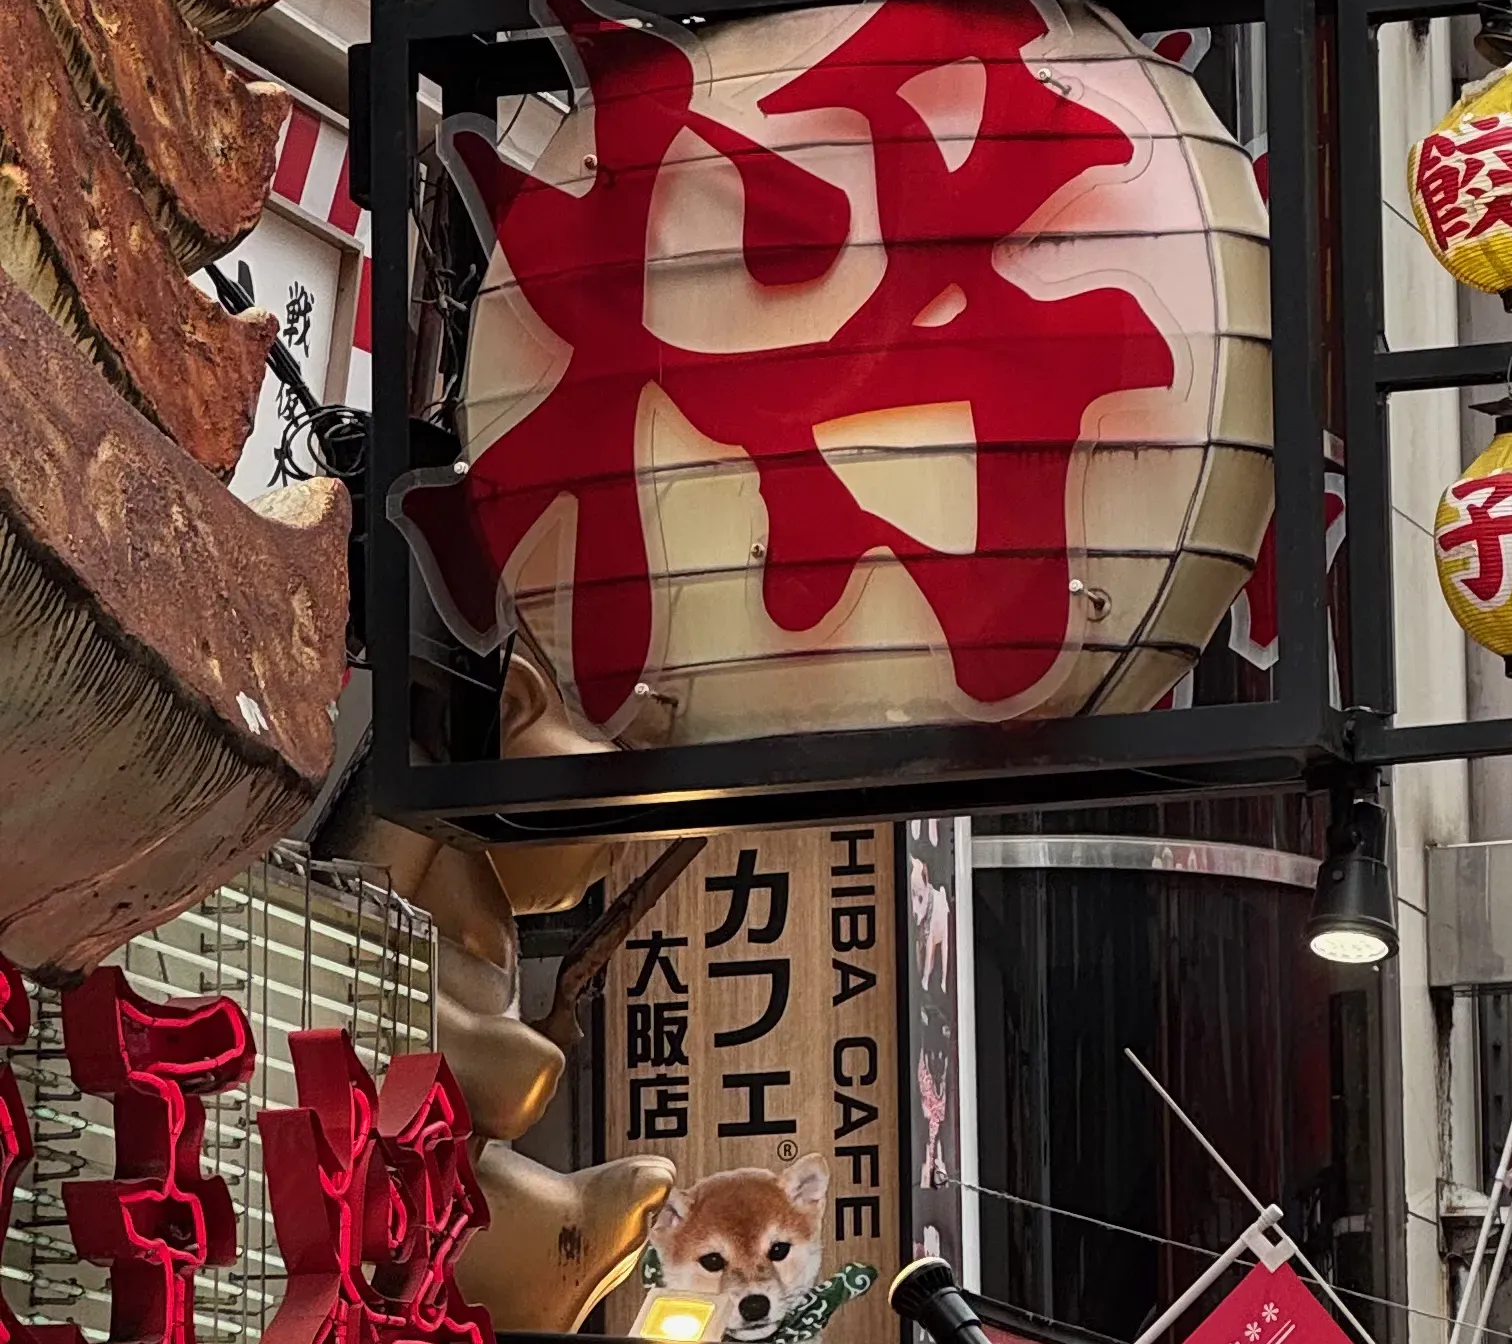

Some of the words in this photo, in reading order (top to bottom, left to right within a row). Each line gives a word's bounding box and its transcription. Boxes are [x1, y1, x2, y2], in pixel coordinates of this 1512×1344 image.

[626, 930, 689, 1141] 大阪店
[833, 1036, 881, 1242] CAFE
